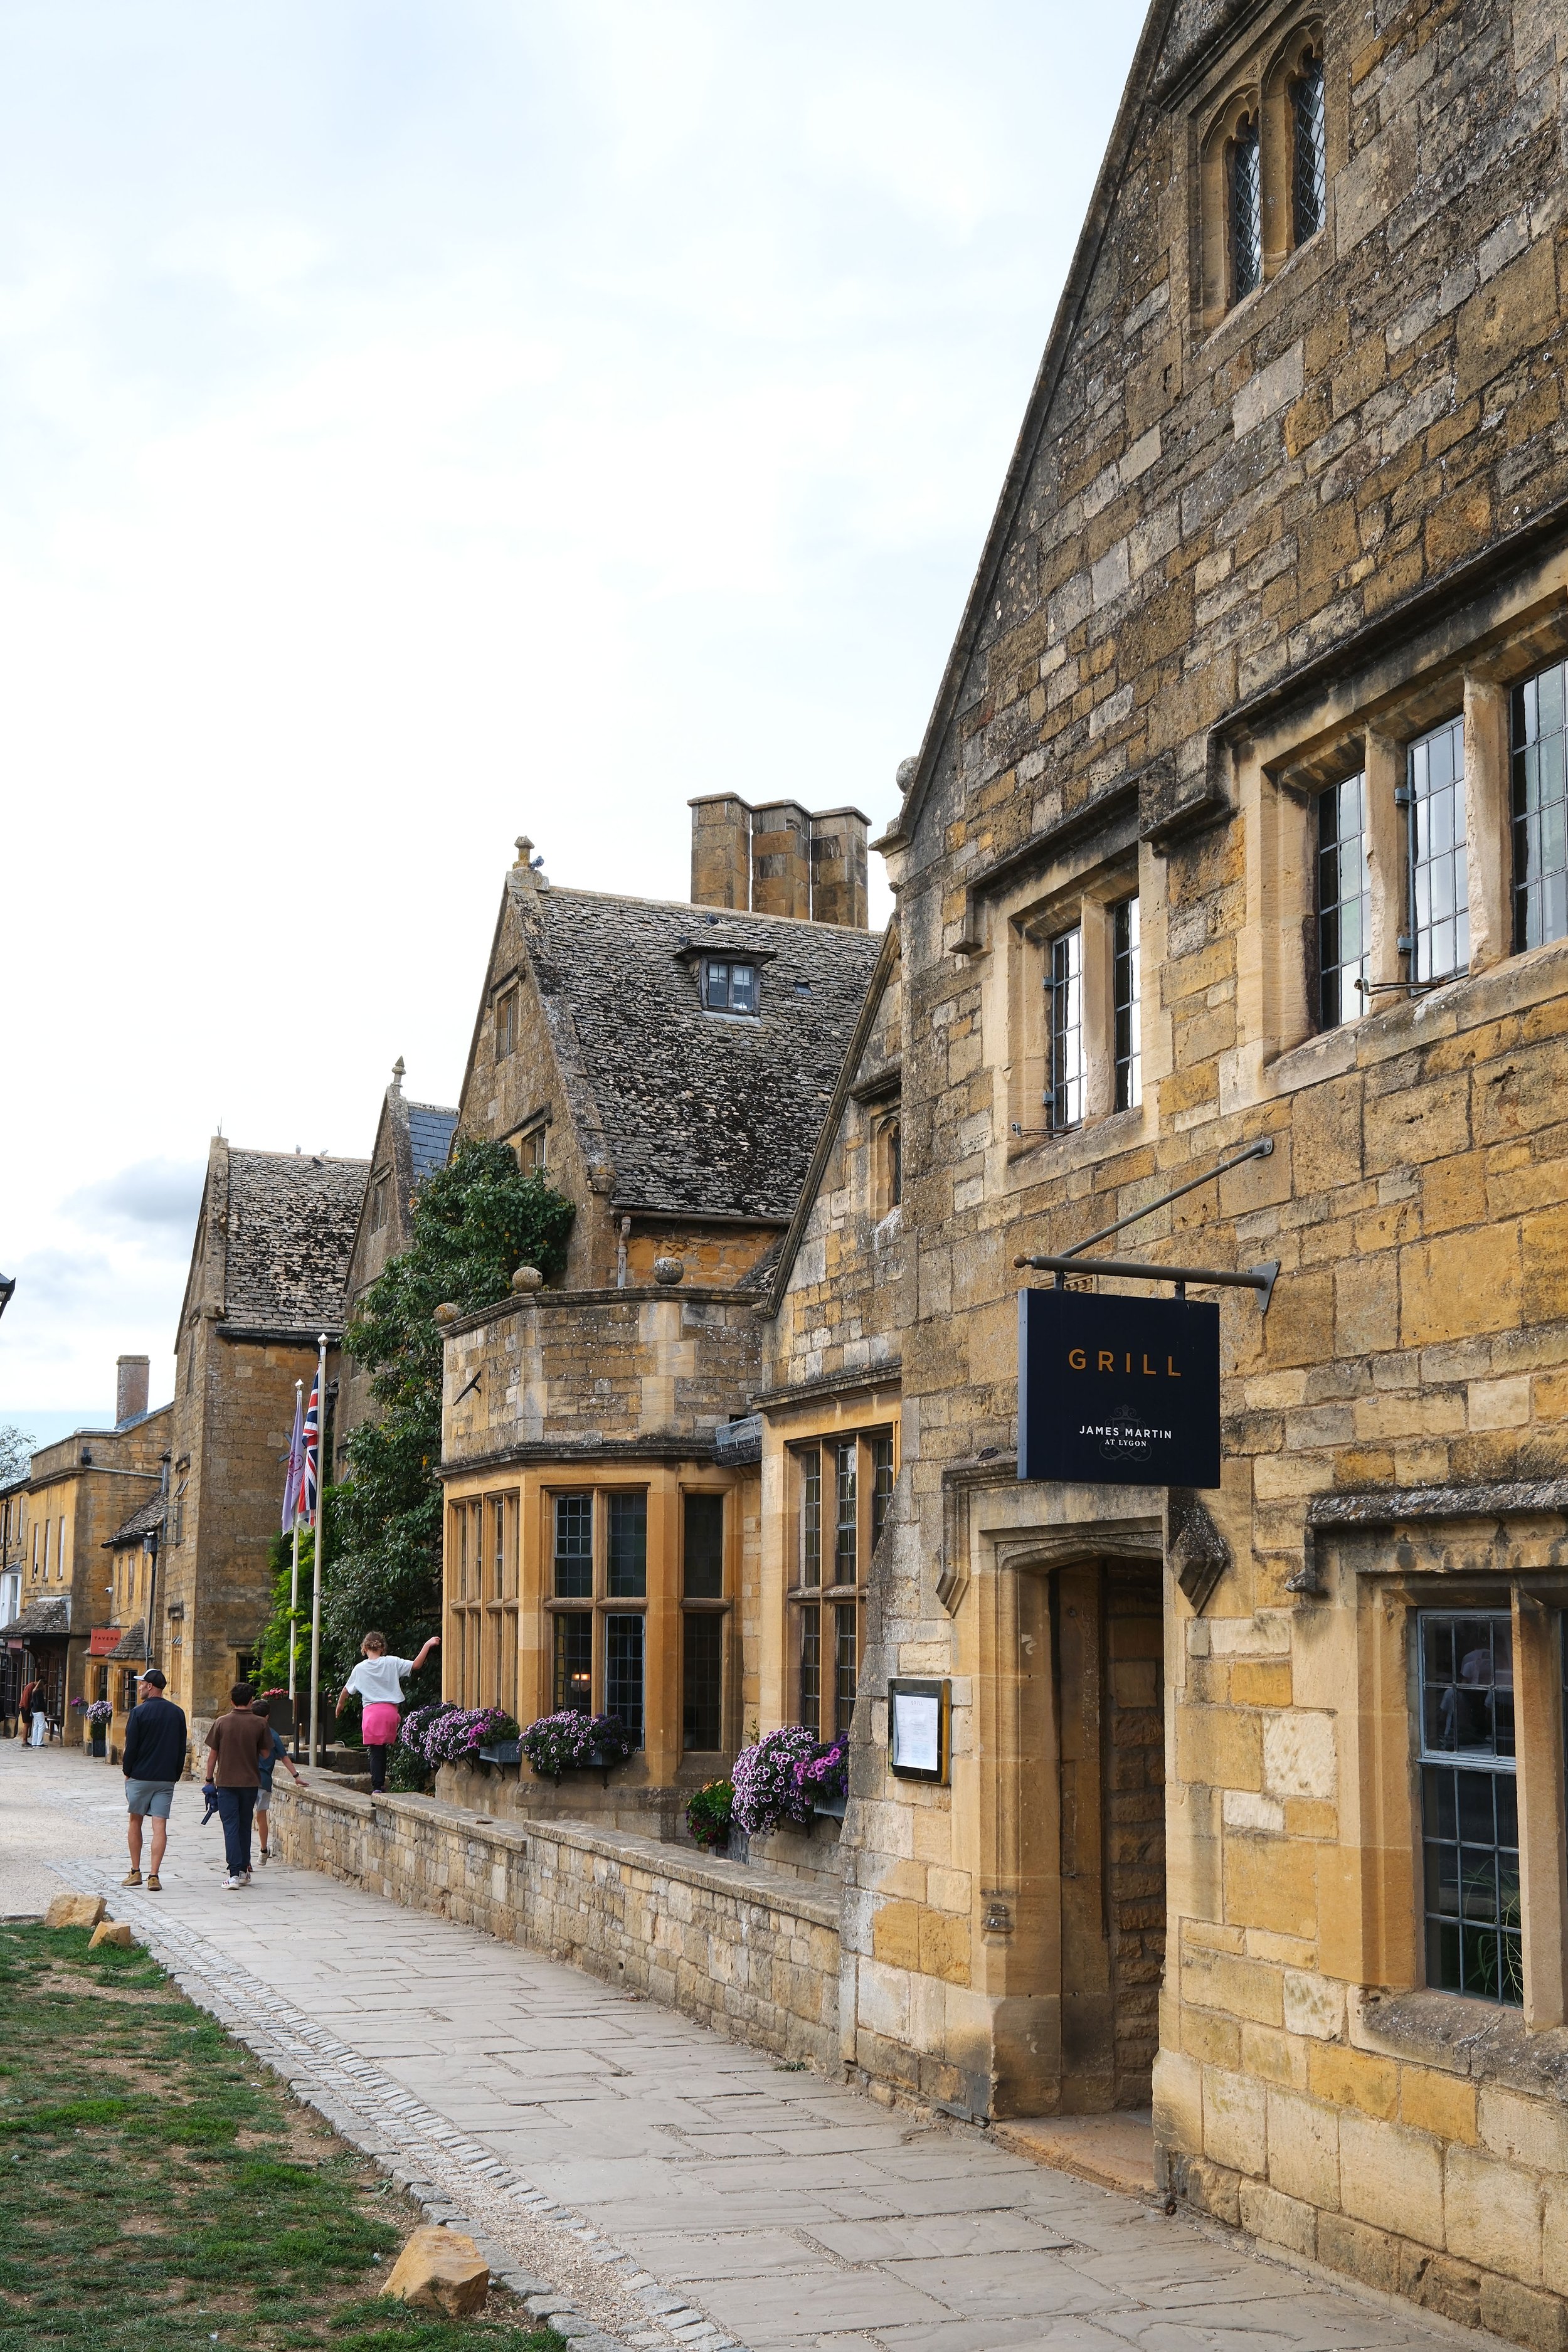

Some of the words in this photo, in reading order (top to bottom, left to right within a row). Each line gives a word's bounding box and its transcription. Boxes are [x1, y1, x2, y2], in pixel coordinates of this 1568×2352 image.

[1068, 1348, 1182, 1377] GRILL
[1079, 1425, 1120, 1436] JAMES
[1125, 1428, 1172, 1439] MARTIN
